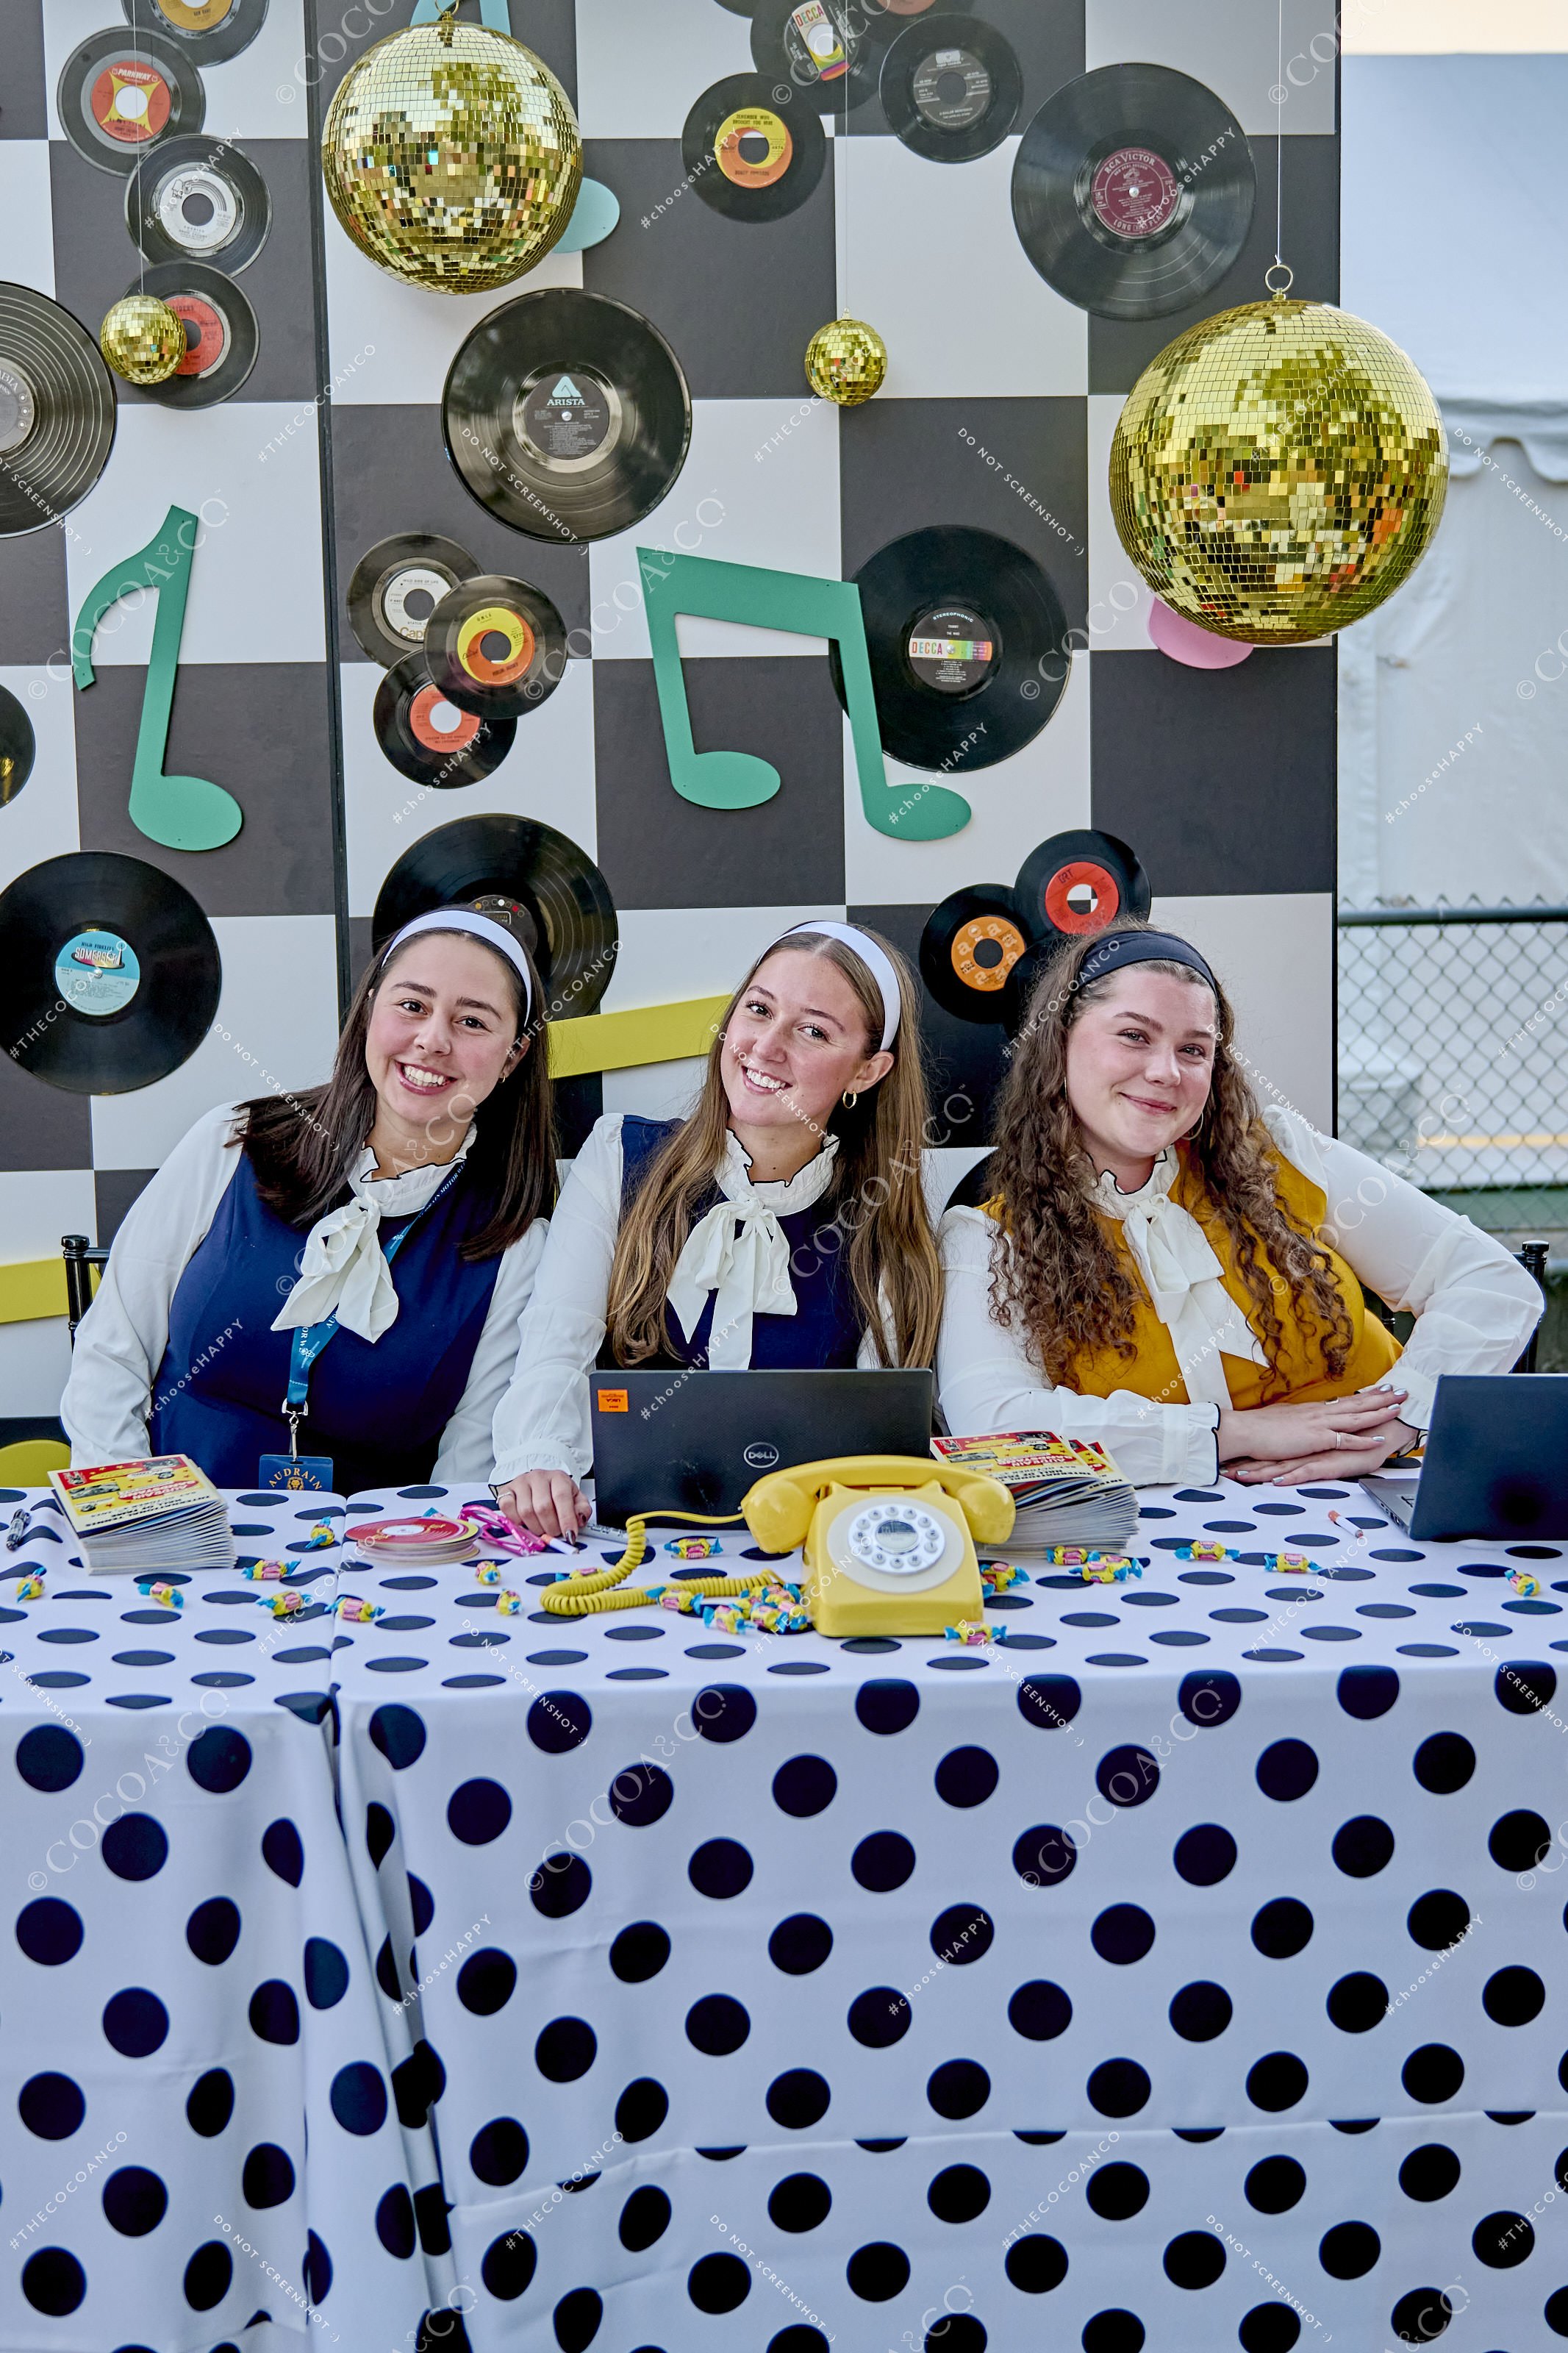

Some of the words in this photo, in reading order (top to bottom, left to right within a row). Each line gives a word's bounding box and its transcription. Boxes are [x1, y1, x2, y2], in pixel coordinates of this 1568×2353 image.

[795, 4, 824, 27] DECCA
[118, 68, 151, 81] PARKWAY
[1104, 158, 1121, 174] RCA
[1120, 151, 1156, 166] VICTOR
[1112, 218, 1132, 231] LONG
[546, 398, 586, 406] ARISTA
[932, 611, 974, 623] STEREOPHONIC
[912, 641, 942, 654] DECCA
[94, 943, 114, 951] FIDELITY
[440, 1172, 458, 1194] MOTOR
[748, 1451, 776, 1460] DELL
[268, 1467, 323, 1490] AUDRAIN
